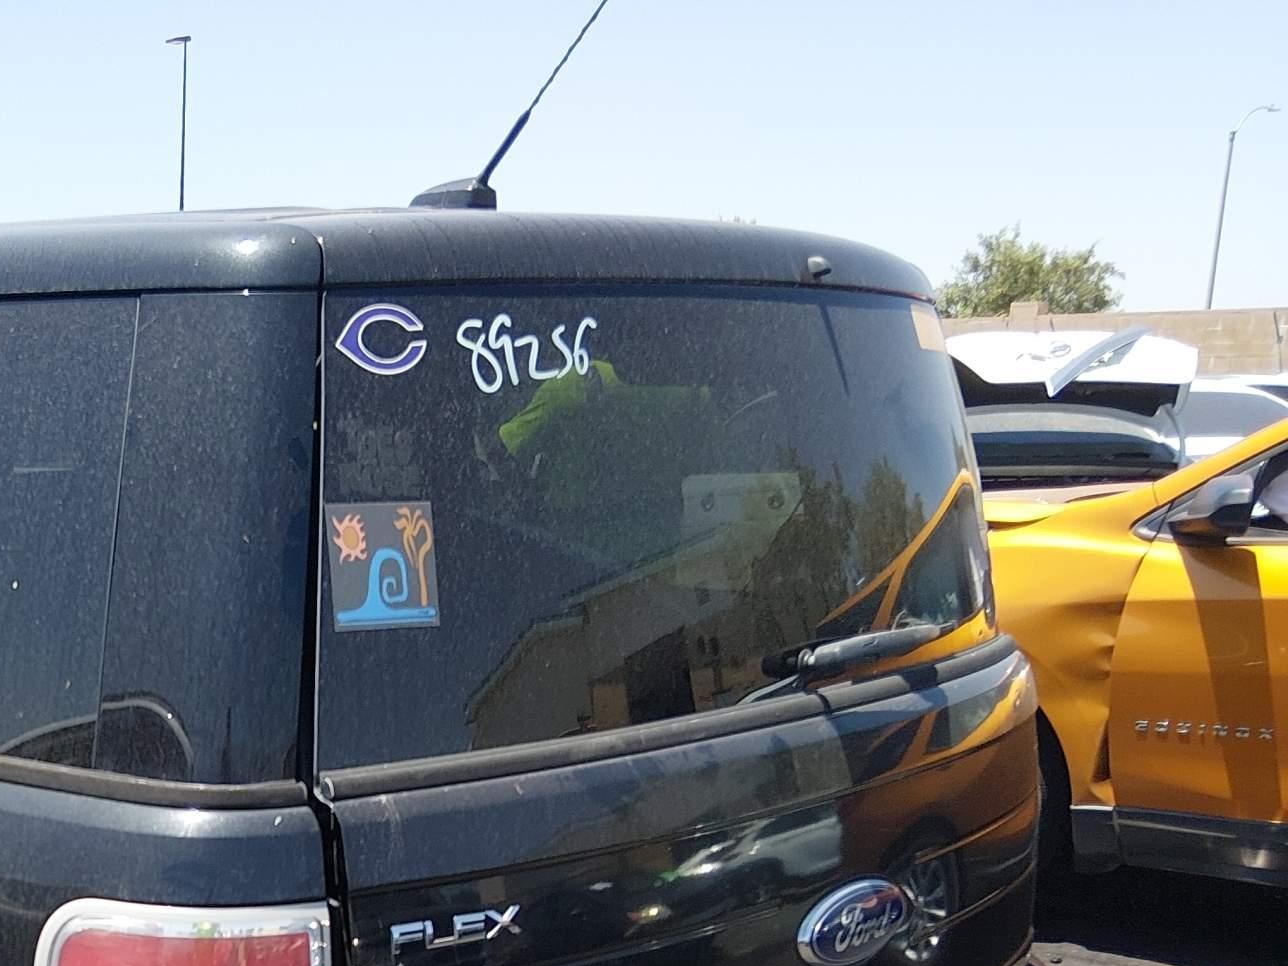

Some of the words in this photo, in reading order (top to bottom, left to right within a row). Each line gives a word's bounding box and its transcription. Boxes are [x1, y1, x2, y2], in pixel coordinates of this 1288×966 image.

[456, 313, 598, 394] 89256
[390, 904, 522, 956] FLEX
[825, 901, 892, 953] Ford
